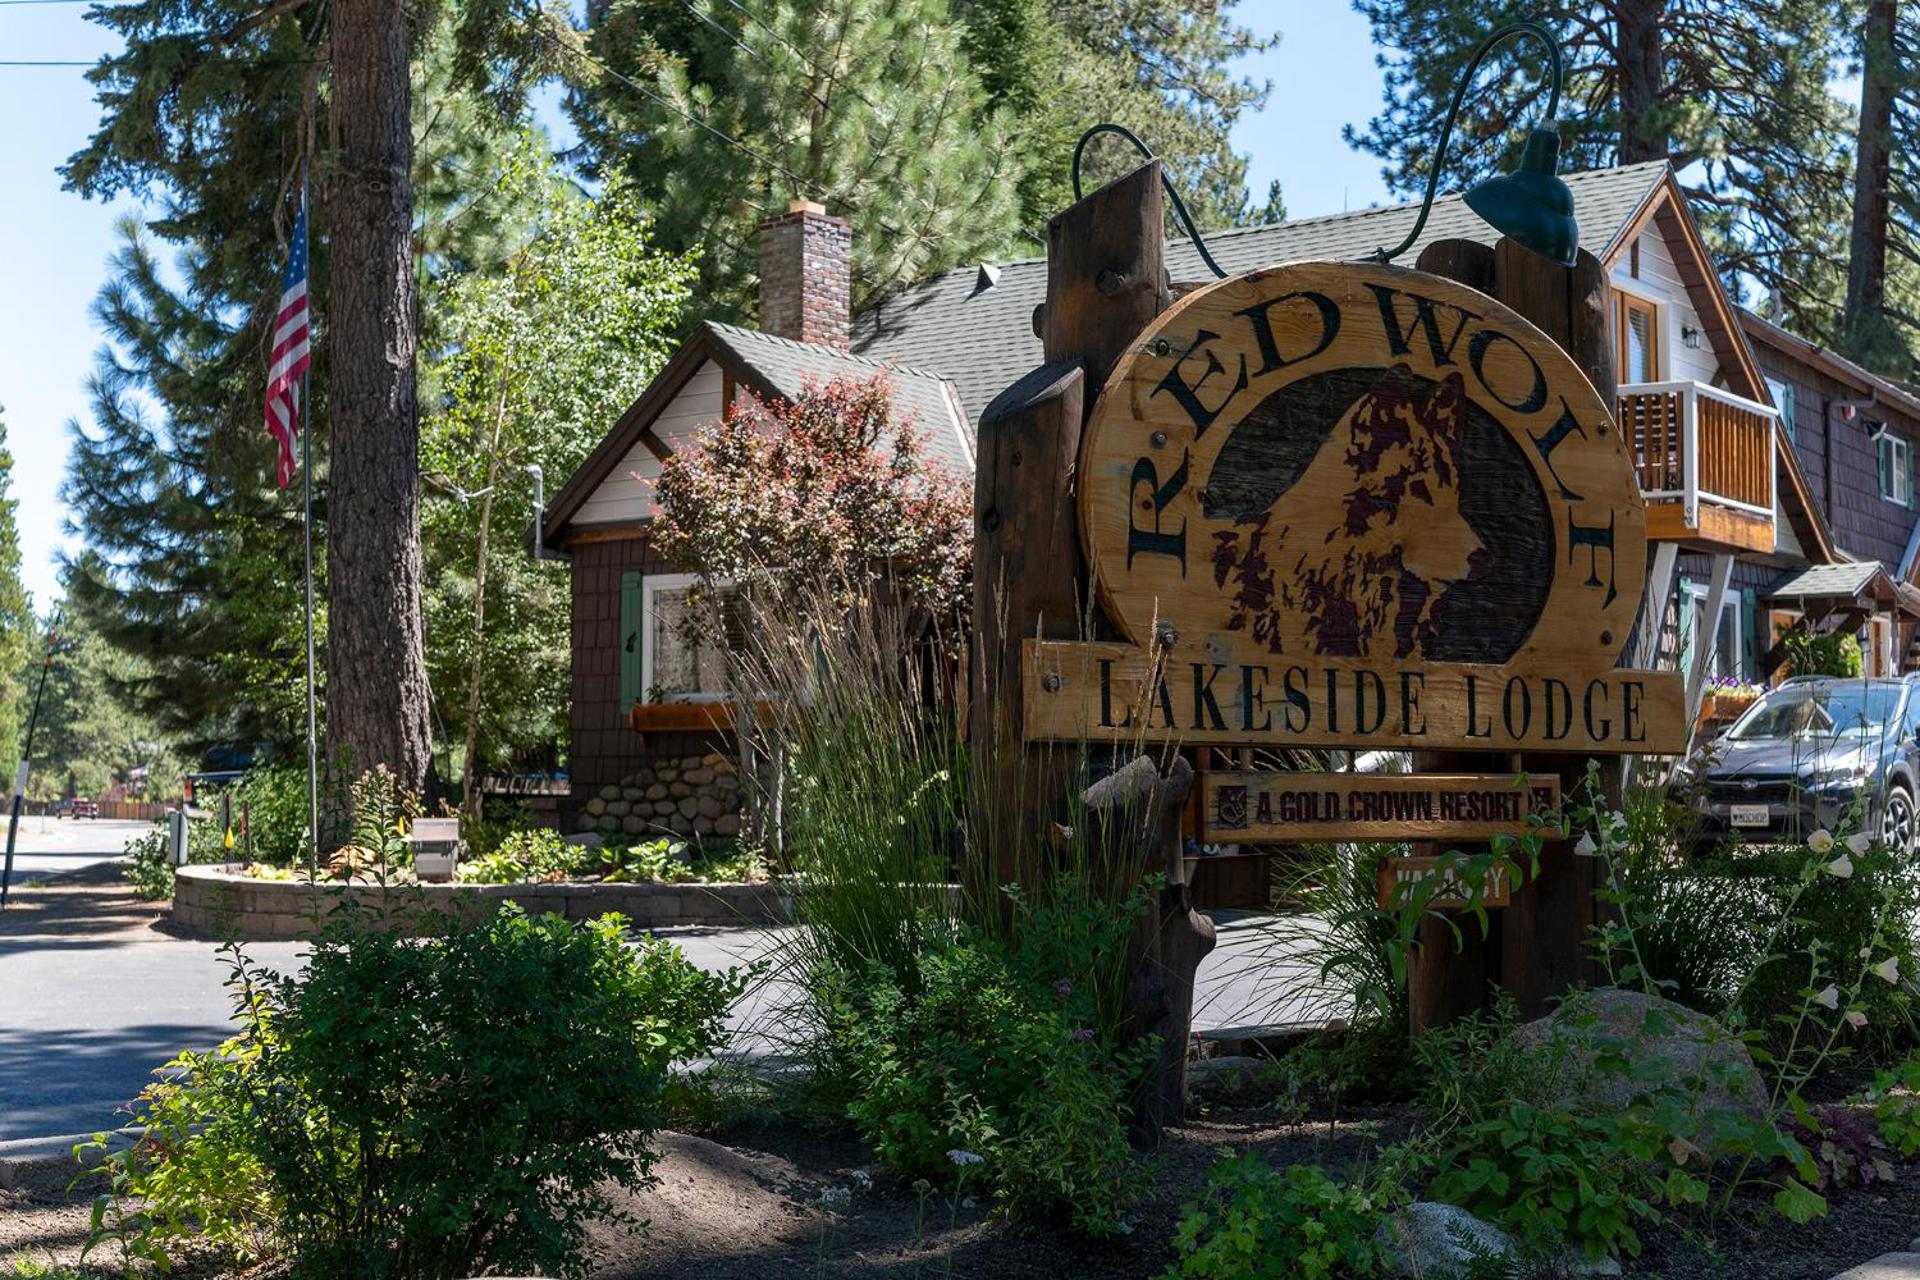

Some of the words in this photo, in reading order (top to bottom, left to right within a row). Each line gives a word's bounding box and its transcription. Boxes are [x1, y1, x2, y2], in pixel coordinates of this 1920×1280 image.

[1127, 289, 1343, 581] RED
[1364, 282, 1617, 611] WOLF
[1097, 659, 1426, 737] LAKESIDE
[1463, 675, 1646, 741] LODGE
[1257, 791, 1273, 823] A
[1280, 791, 1340, 823] GOLD
[1348, 790, 1432, 822] CROWN
[1440, 790, 1522, 822] RESORT
